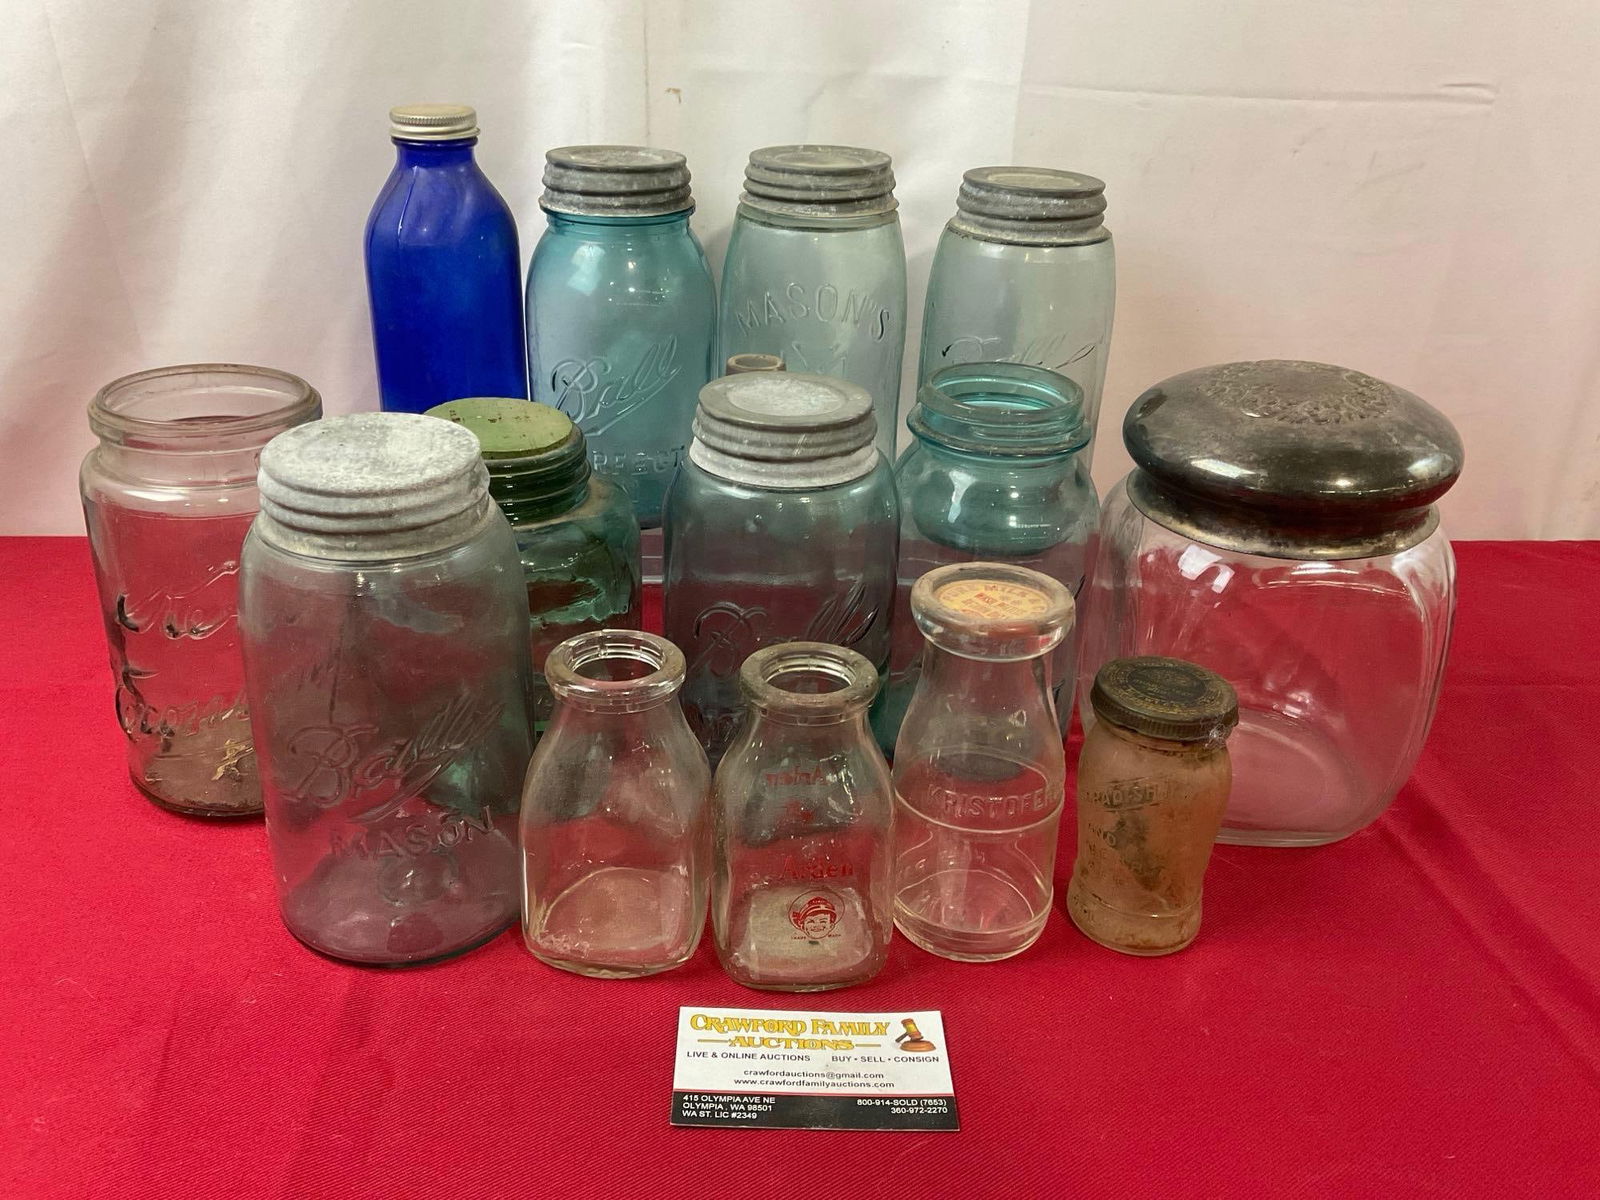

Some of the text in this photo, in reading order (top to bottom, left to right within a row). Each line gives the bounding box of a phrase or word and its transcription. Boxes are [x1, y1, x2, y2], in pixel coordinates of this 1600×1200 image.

[735, 283, 890, 343] MASON'S
[551, 335, 683, 437] Ball
[287, 688, 505, 823] Ball
[329, 805, 496, 860] MASON
[690, 1014, 891, 1037] CRAWFORD FAMILY
[729, 1036, 855, 1051] AUCTIONS
[686, 1051, 709, 1059] LIVE
[721, 1052, 758, 1060] ONLINE
[760, 1053, 811, 1062] AUCTIONS
[743, 1069, 884, 1080] crawfordauctions@gmail.com
[734, 1078, 895, 1089] www.crawfordfamilyauctions.com
[700, 1095, 741, 1103] OLYMPIA
[741, 1096, 760, 1104] AVE
[762, 1096, 776, 1104] NE
[919, 1099, 947, 1107] (7653)
[729, 1103, 746, 1111] WA
[682, 1109, 758, 1120] WA ST. LIC #2349
